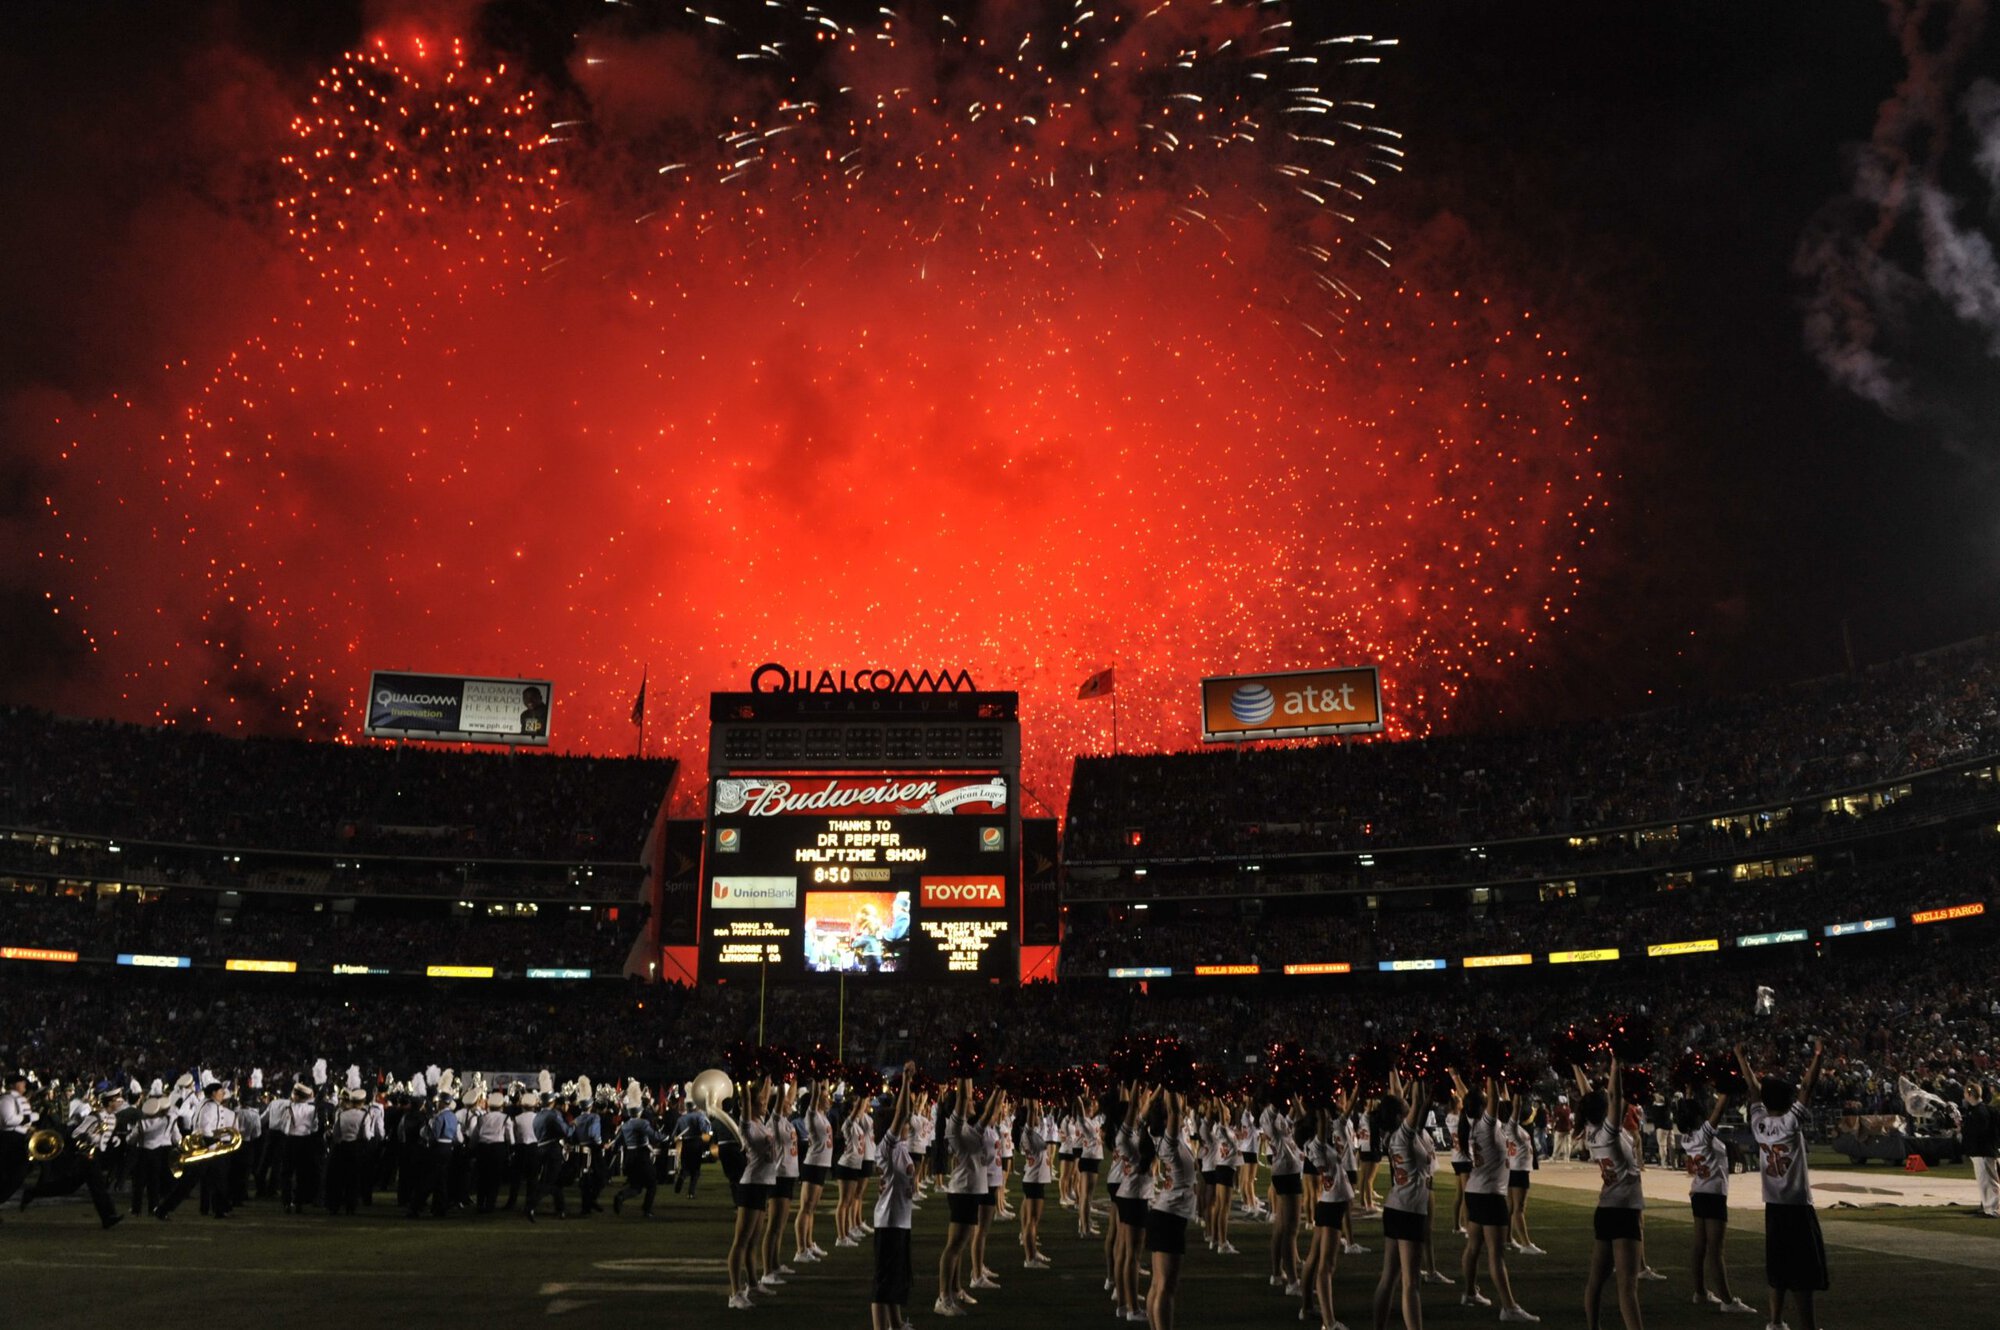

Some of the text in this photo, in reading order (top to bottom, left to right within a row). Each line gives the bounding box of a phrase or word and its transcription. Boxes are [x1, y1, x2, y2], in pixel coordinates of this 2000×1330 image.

[751, 662, 977, 693] QUALCOMM
[376, 690, 457, 707] QUALCOMM
[797, 700, 958, 711] STADIUM
[1283, 682, 1356, 715] at&t
[741, 779, 937, 816] Budweiser
[939, 789, 1004, 808] American Lager
[828, 820, 891, 831] THANKS TO
[817, 833, 900, 847] DR PEPPER
[795, 848, 927, 862] HALFTIME SHOW
[734, 888, 794, 898] UnionBank
[924, 884, 1002, 900] TOYOTA
[1912, 904, 1984, 924] WELLS FARGO
[1472, 955, 1523, 967] CYMER
[1197, 966, 1258, 975] WELLS FARGO
